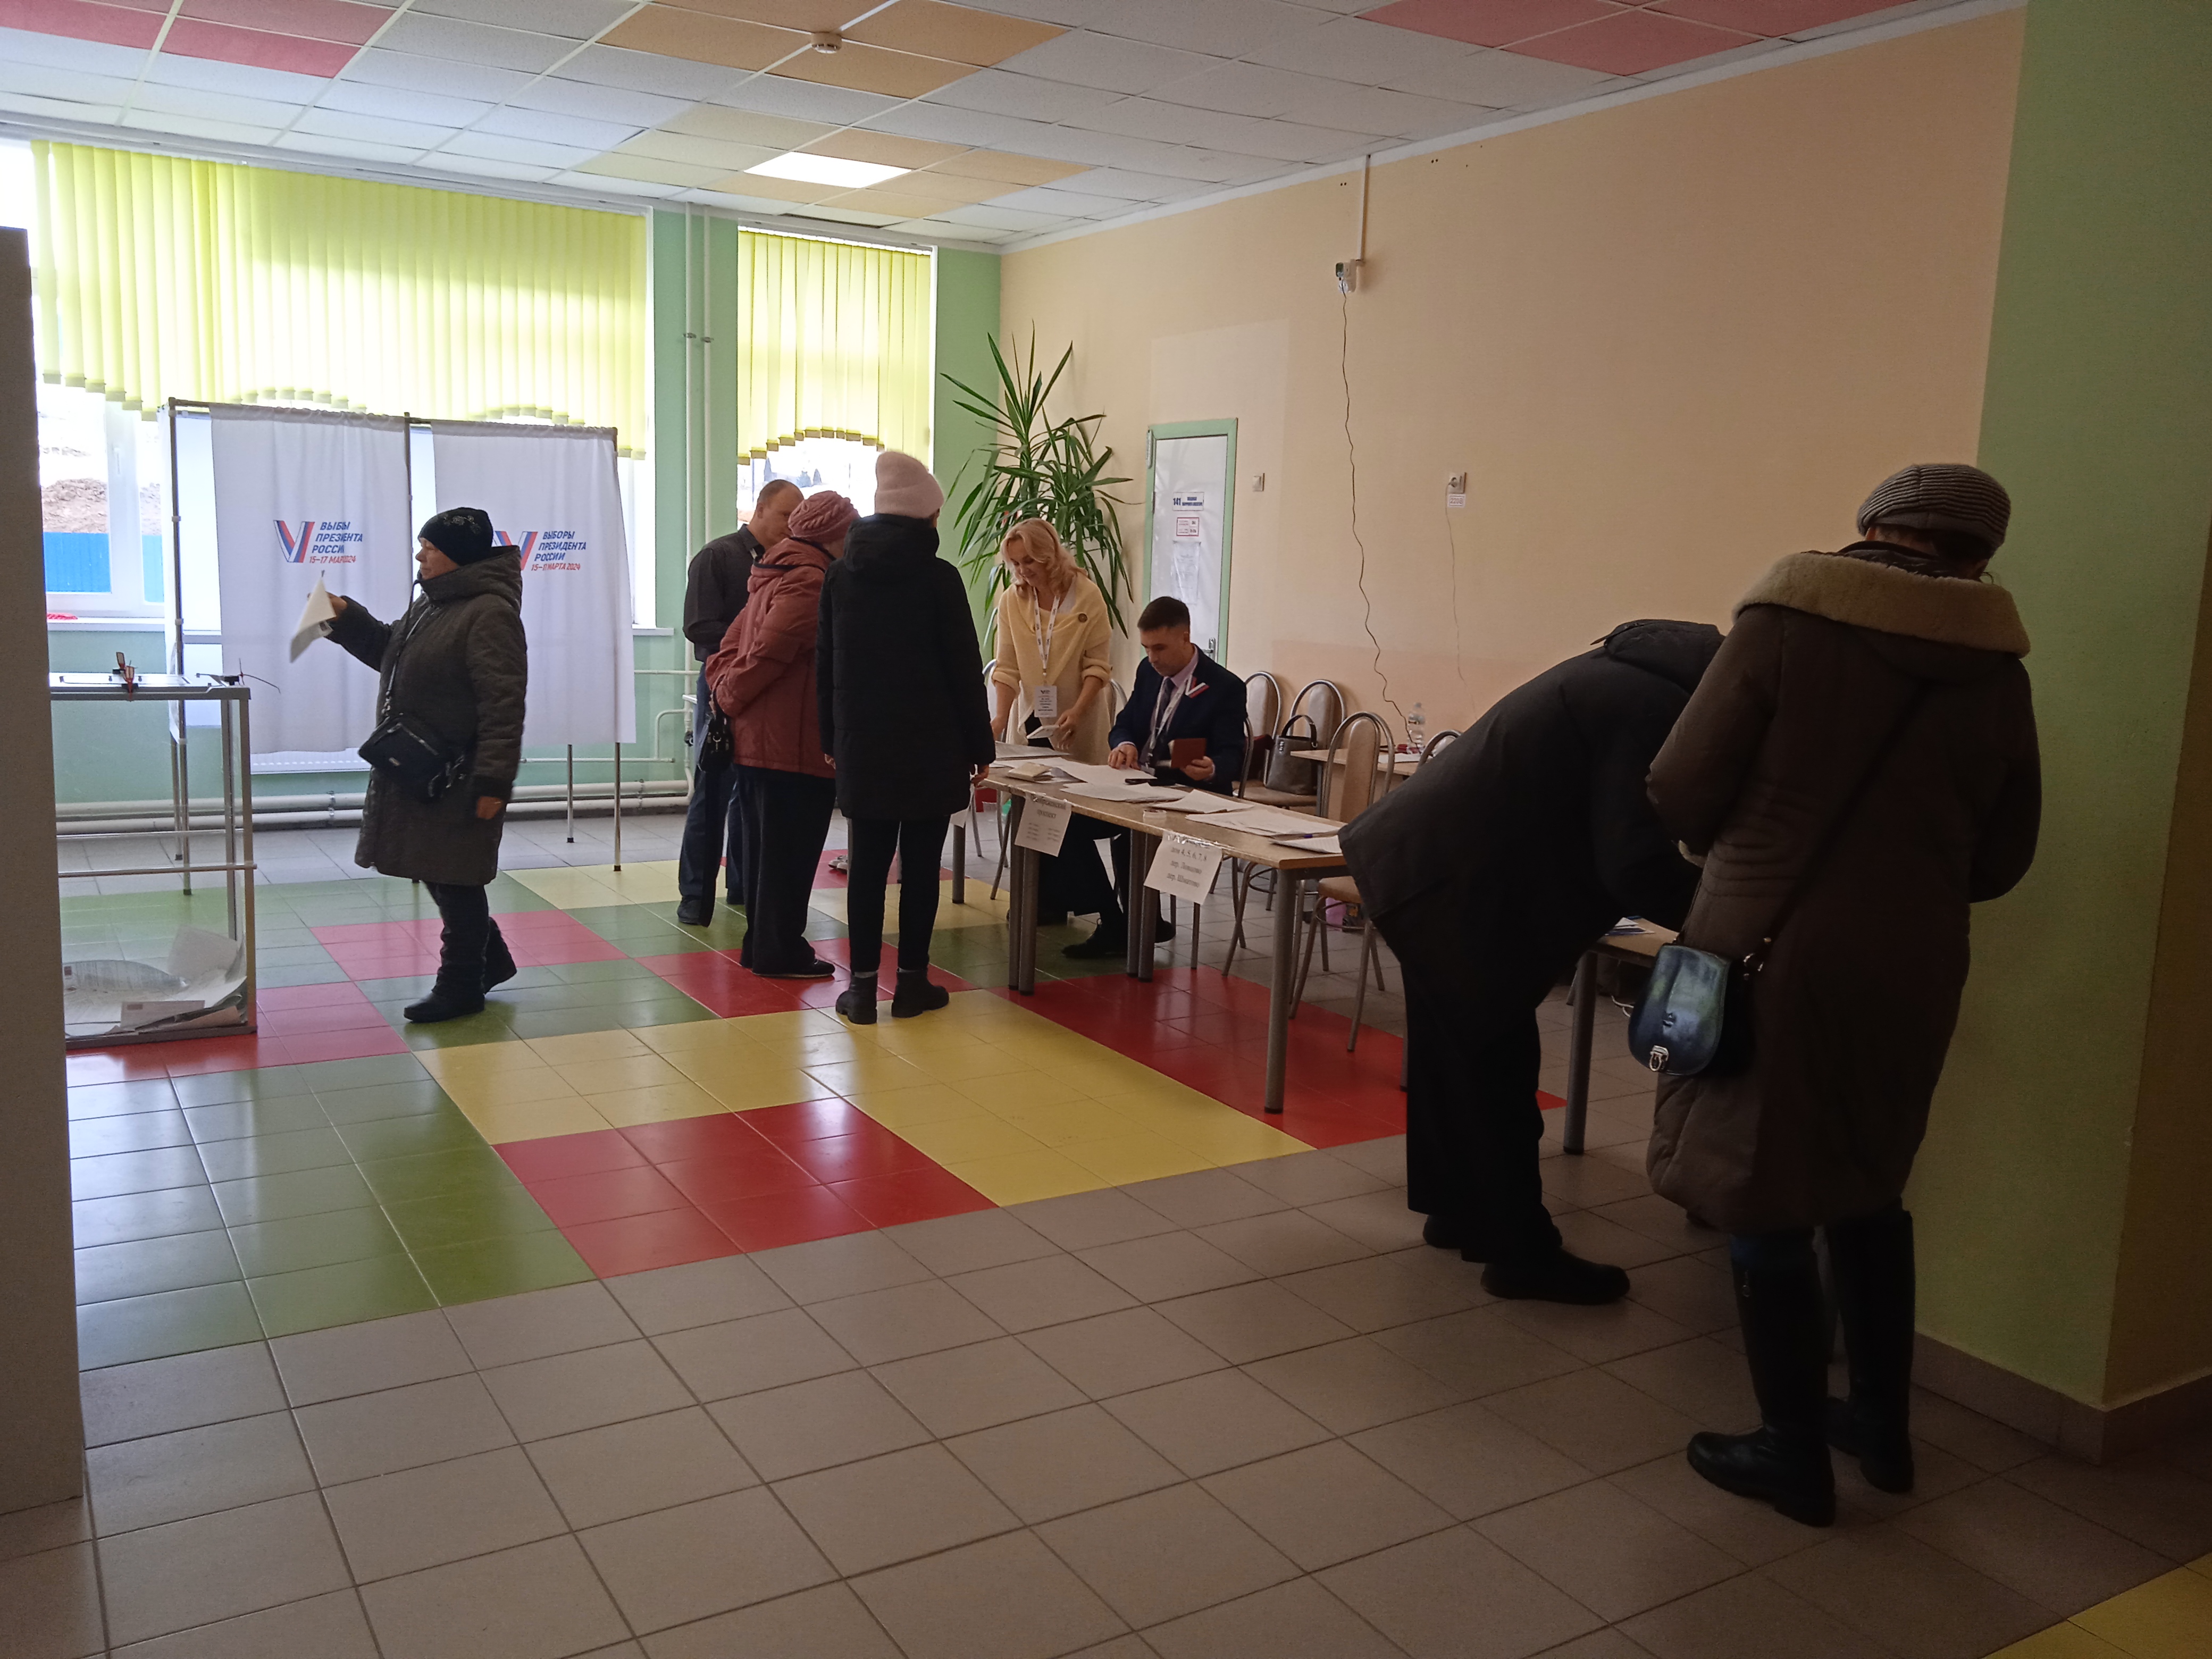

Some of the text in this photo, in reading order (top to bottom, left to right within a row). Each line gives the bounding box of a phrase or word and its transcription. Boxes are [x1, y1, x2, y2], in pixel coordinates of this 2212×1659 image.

[320, 522, 350, 530] ВЫБЫ
[315, 533, 363, 542] ПРЕЗЕНТА
[542, 531, 575, 540] ВЫБОРЫ
[538, 541, 586, 551] ПРЕЗИДЕНТА
[534, 552, 566, 562] РОССИИ
